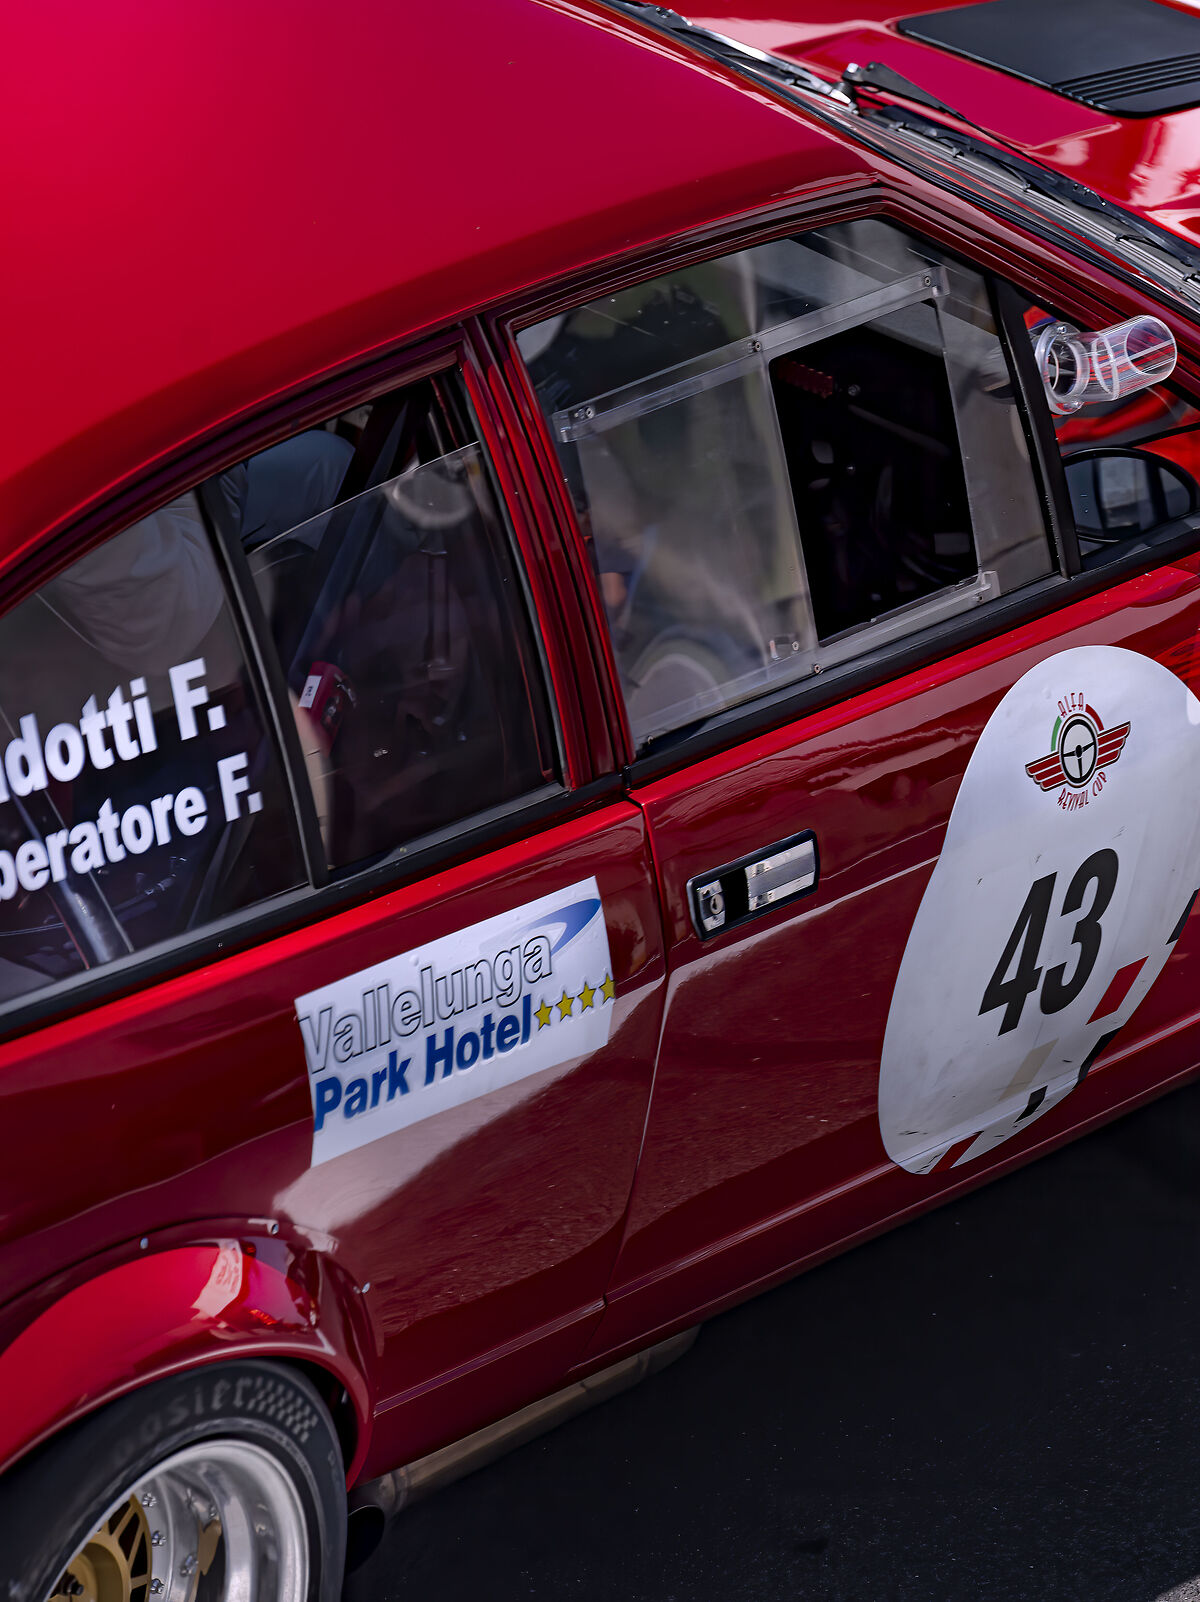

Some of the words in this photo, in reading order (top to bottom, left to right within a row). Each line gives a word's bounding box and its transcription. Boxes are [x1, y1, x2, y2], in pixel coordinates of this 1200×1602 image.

[0, 676, 157, 802] dotti
[169, 657, 227, 741] F.
[1057, 692, 1084, 719] ALFA
[217, 751, 264, 822] F.
[1057, 787, 1090, 812] REVIVAL
[1092, 771, 1108, 797] CUP
[299, 935, 553, 1074] Vallelunga
[978, 848, 1119, 1036] 43
[313, 1050, 412, 1134] Park
[424, 994, 532, 1088] Hotel
